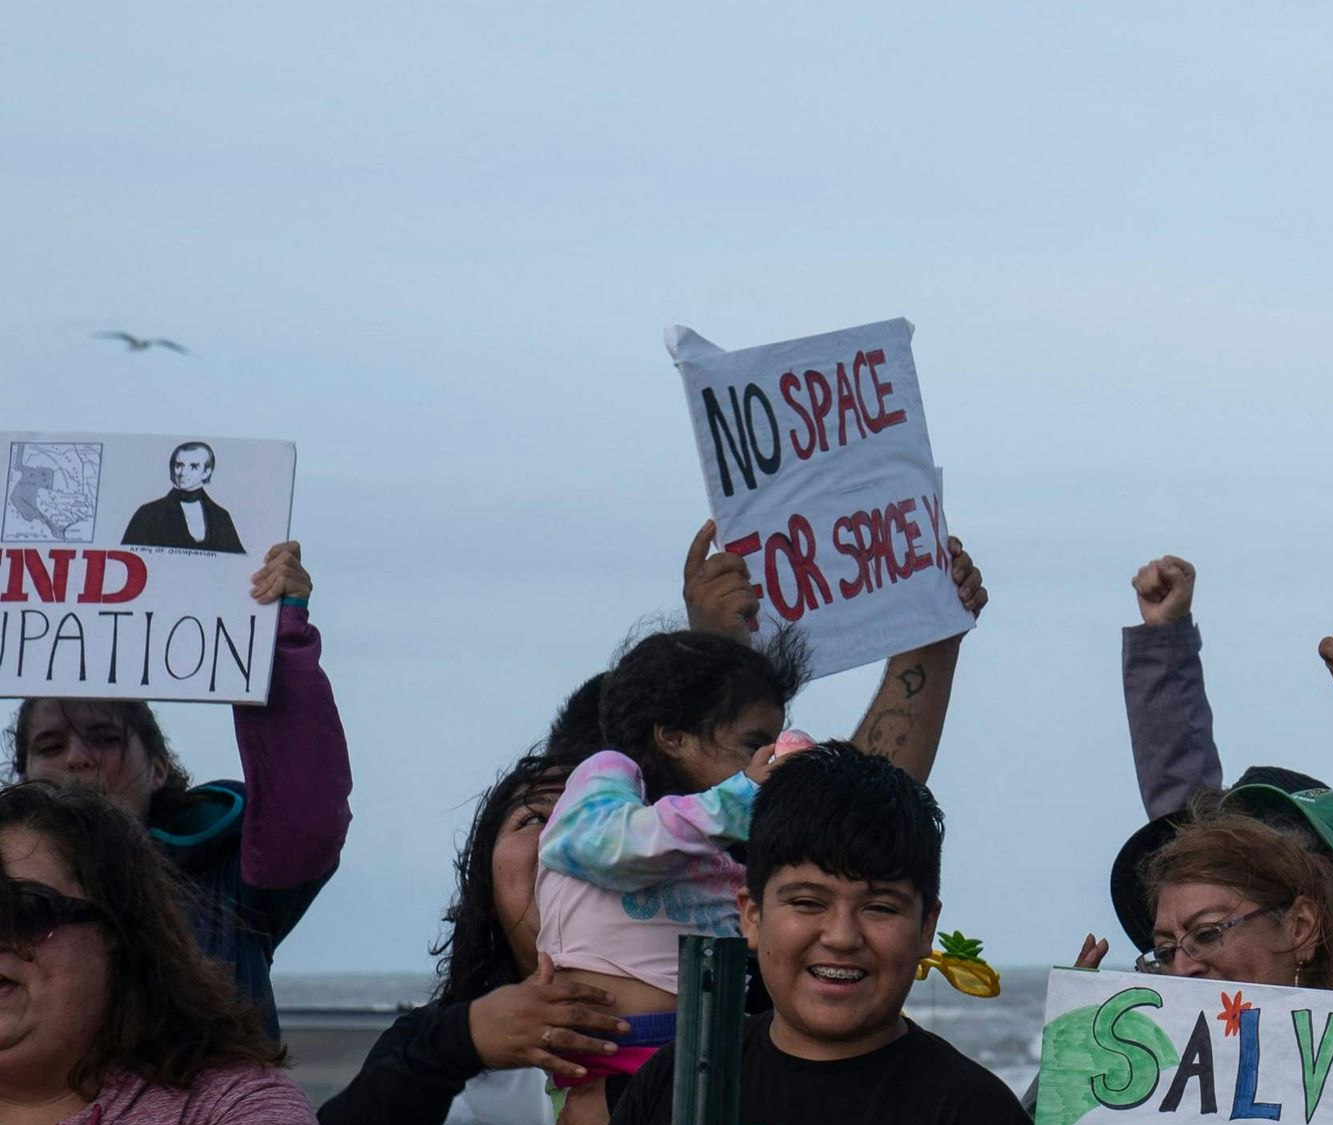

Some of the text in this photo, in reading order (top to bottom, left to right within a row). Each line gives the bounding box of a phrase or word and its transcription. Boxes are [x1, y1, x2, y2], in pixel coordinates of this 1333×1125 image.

[702, 349, 907, 497] NO SPACE
[0, 548, 148, 604] ND
